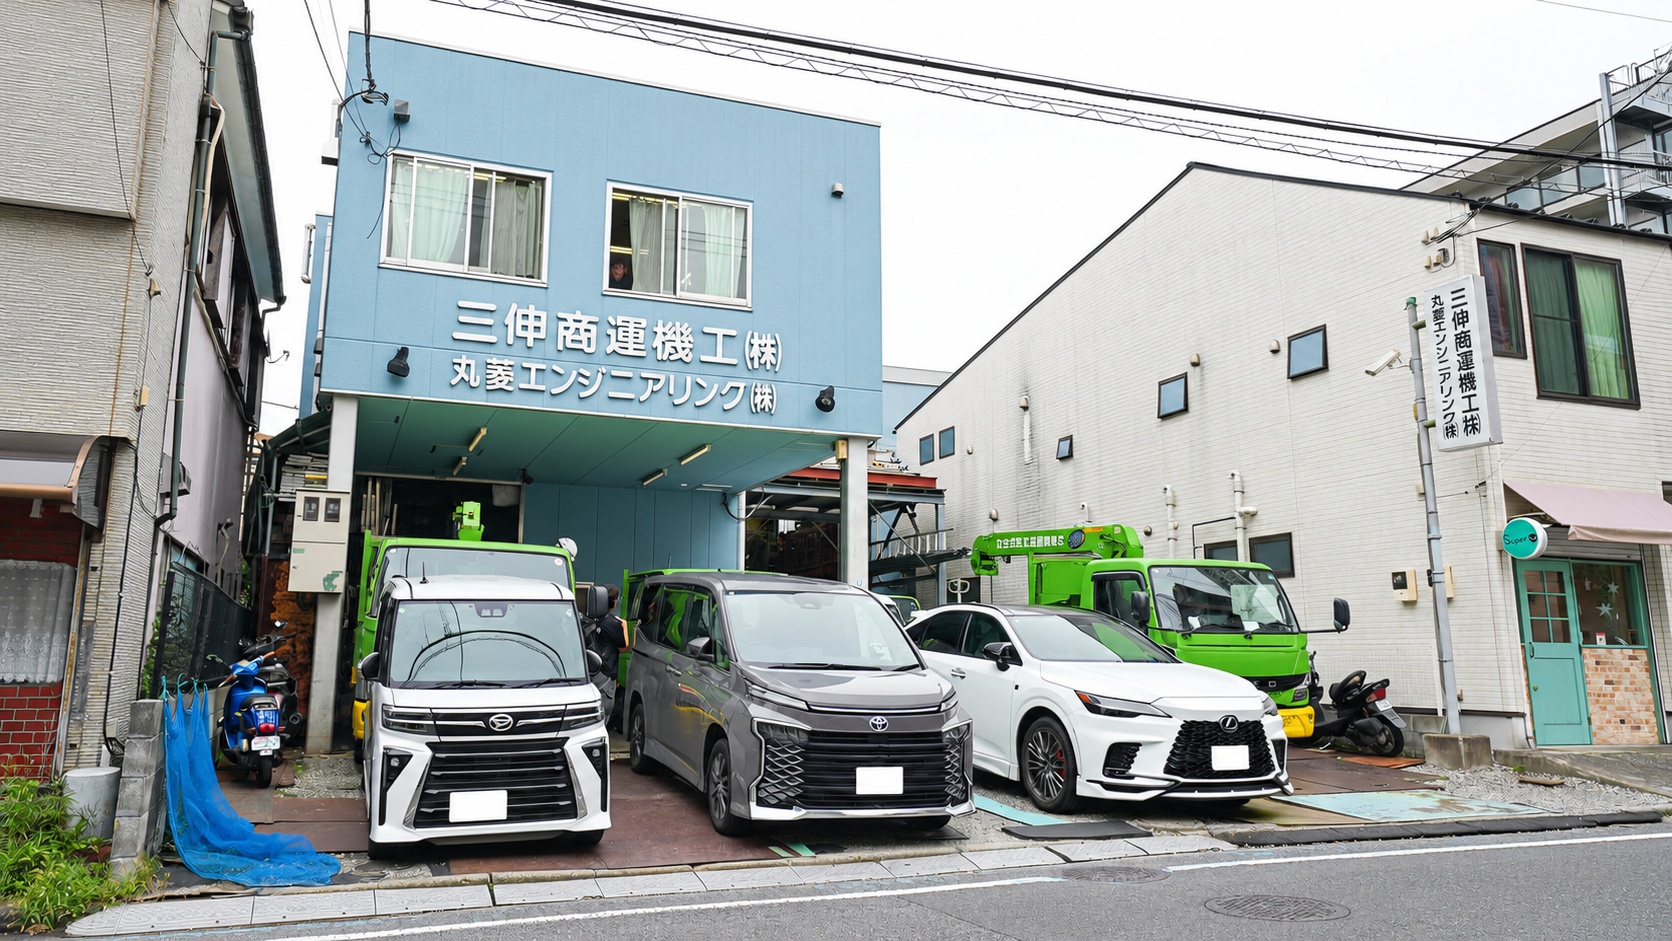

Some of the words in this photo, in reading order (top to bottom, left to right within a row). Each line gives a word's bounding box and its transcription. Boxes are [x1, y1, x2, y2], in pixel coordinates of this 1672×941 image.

[452, 299, 782, 373] 三伸商運機工(株)
